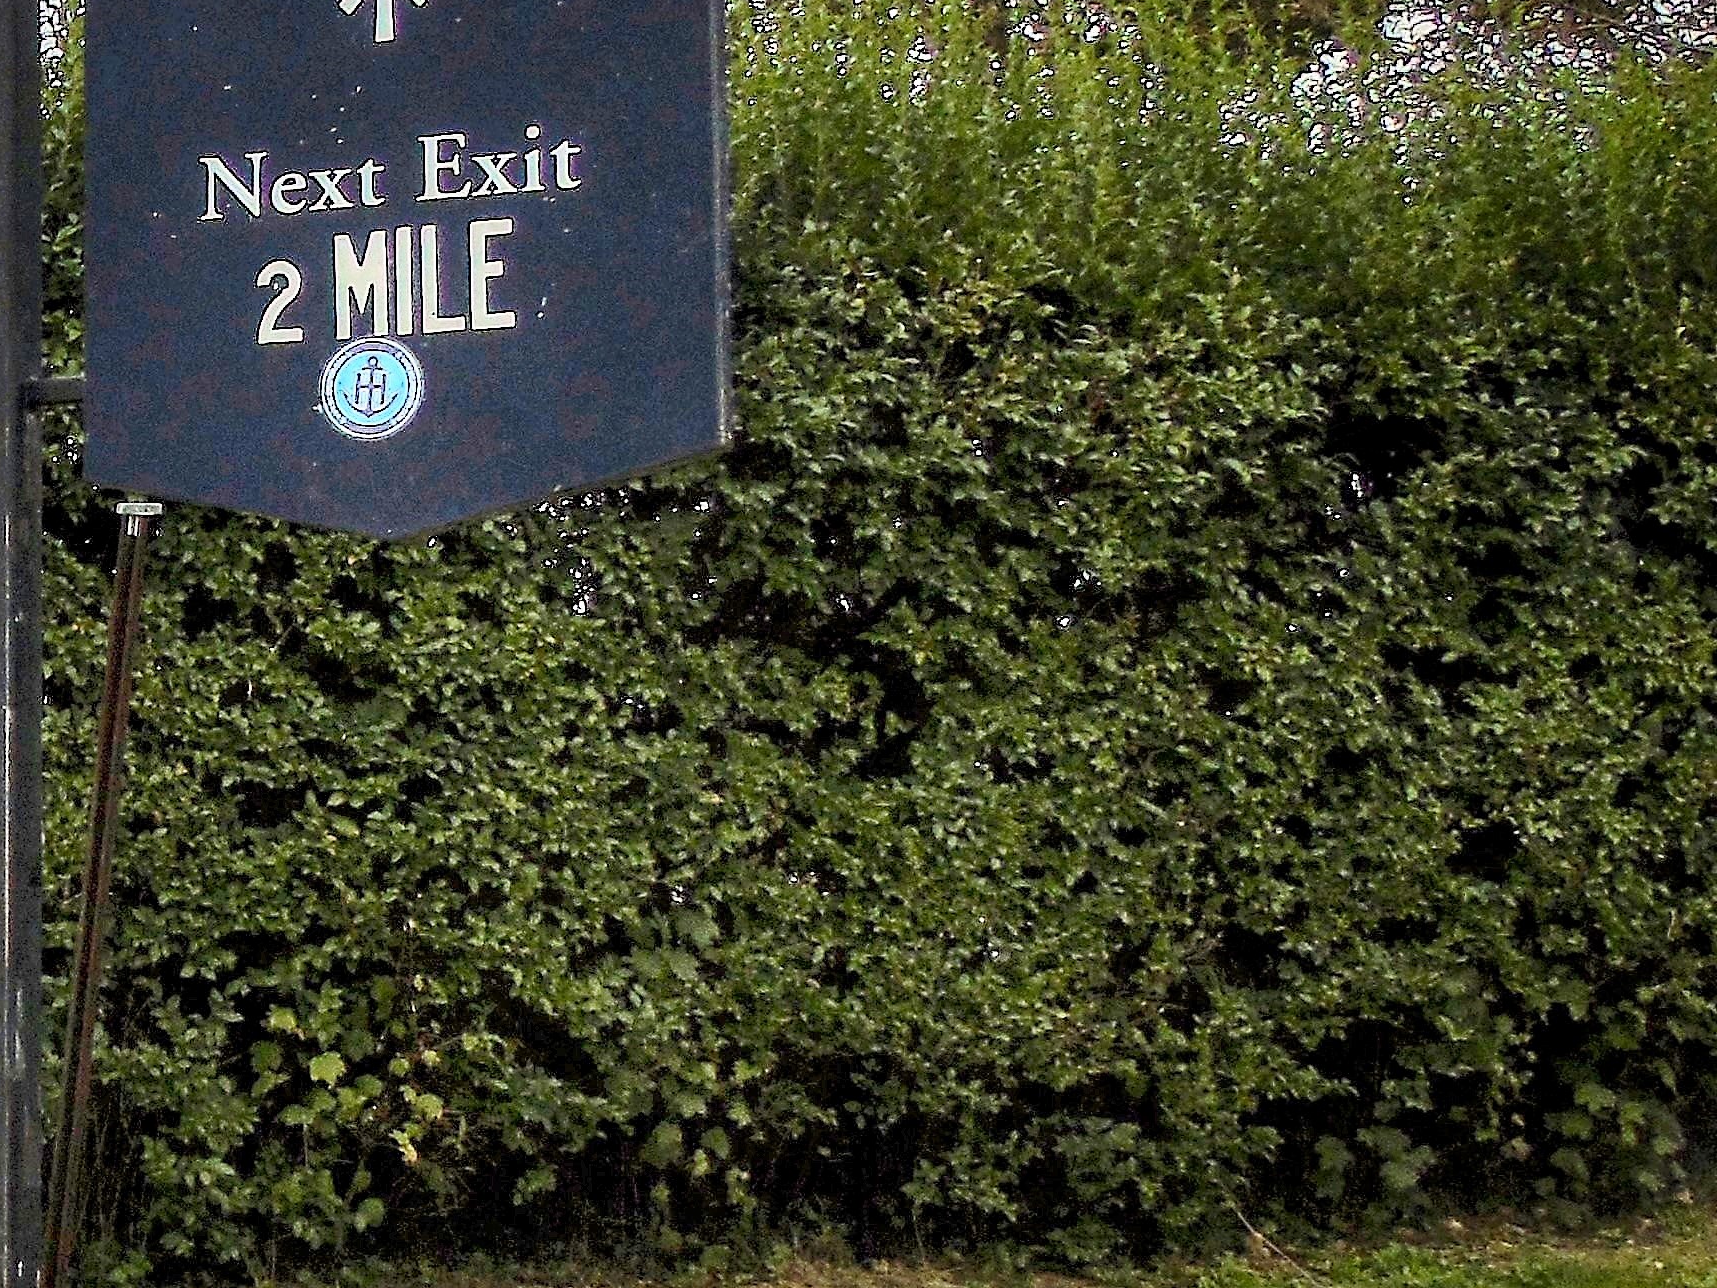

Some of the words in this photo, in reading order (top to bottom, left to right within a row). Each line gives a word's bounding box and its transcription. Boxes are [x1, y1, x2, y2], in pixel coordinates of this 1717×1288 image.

[198, 150, 387, 223] Next
[415, 124, 582, 203] Exit
[254, 258, 305, 346] 2
[332, 217, 517, 341] MILE
